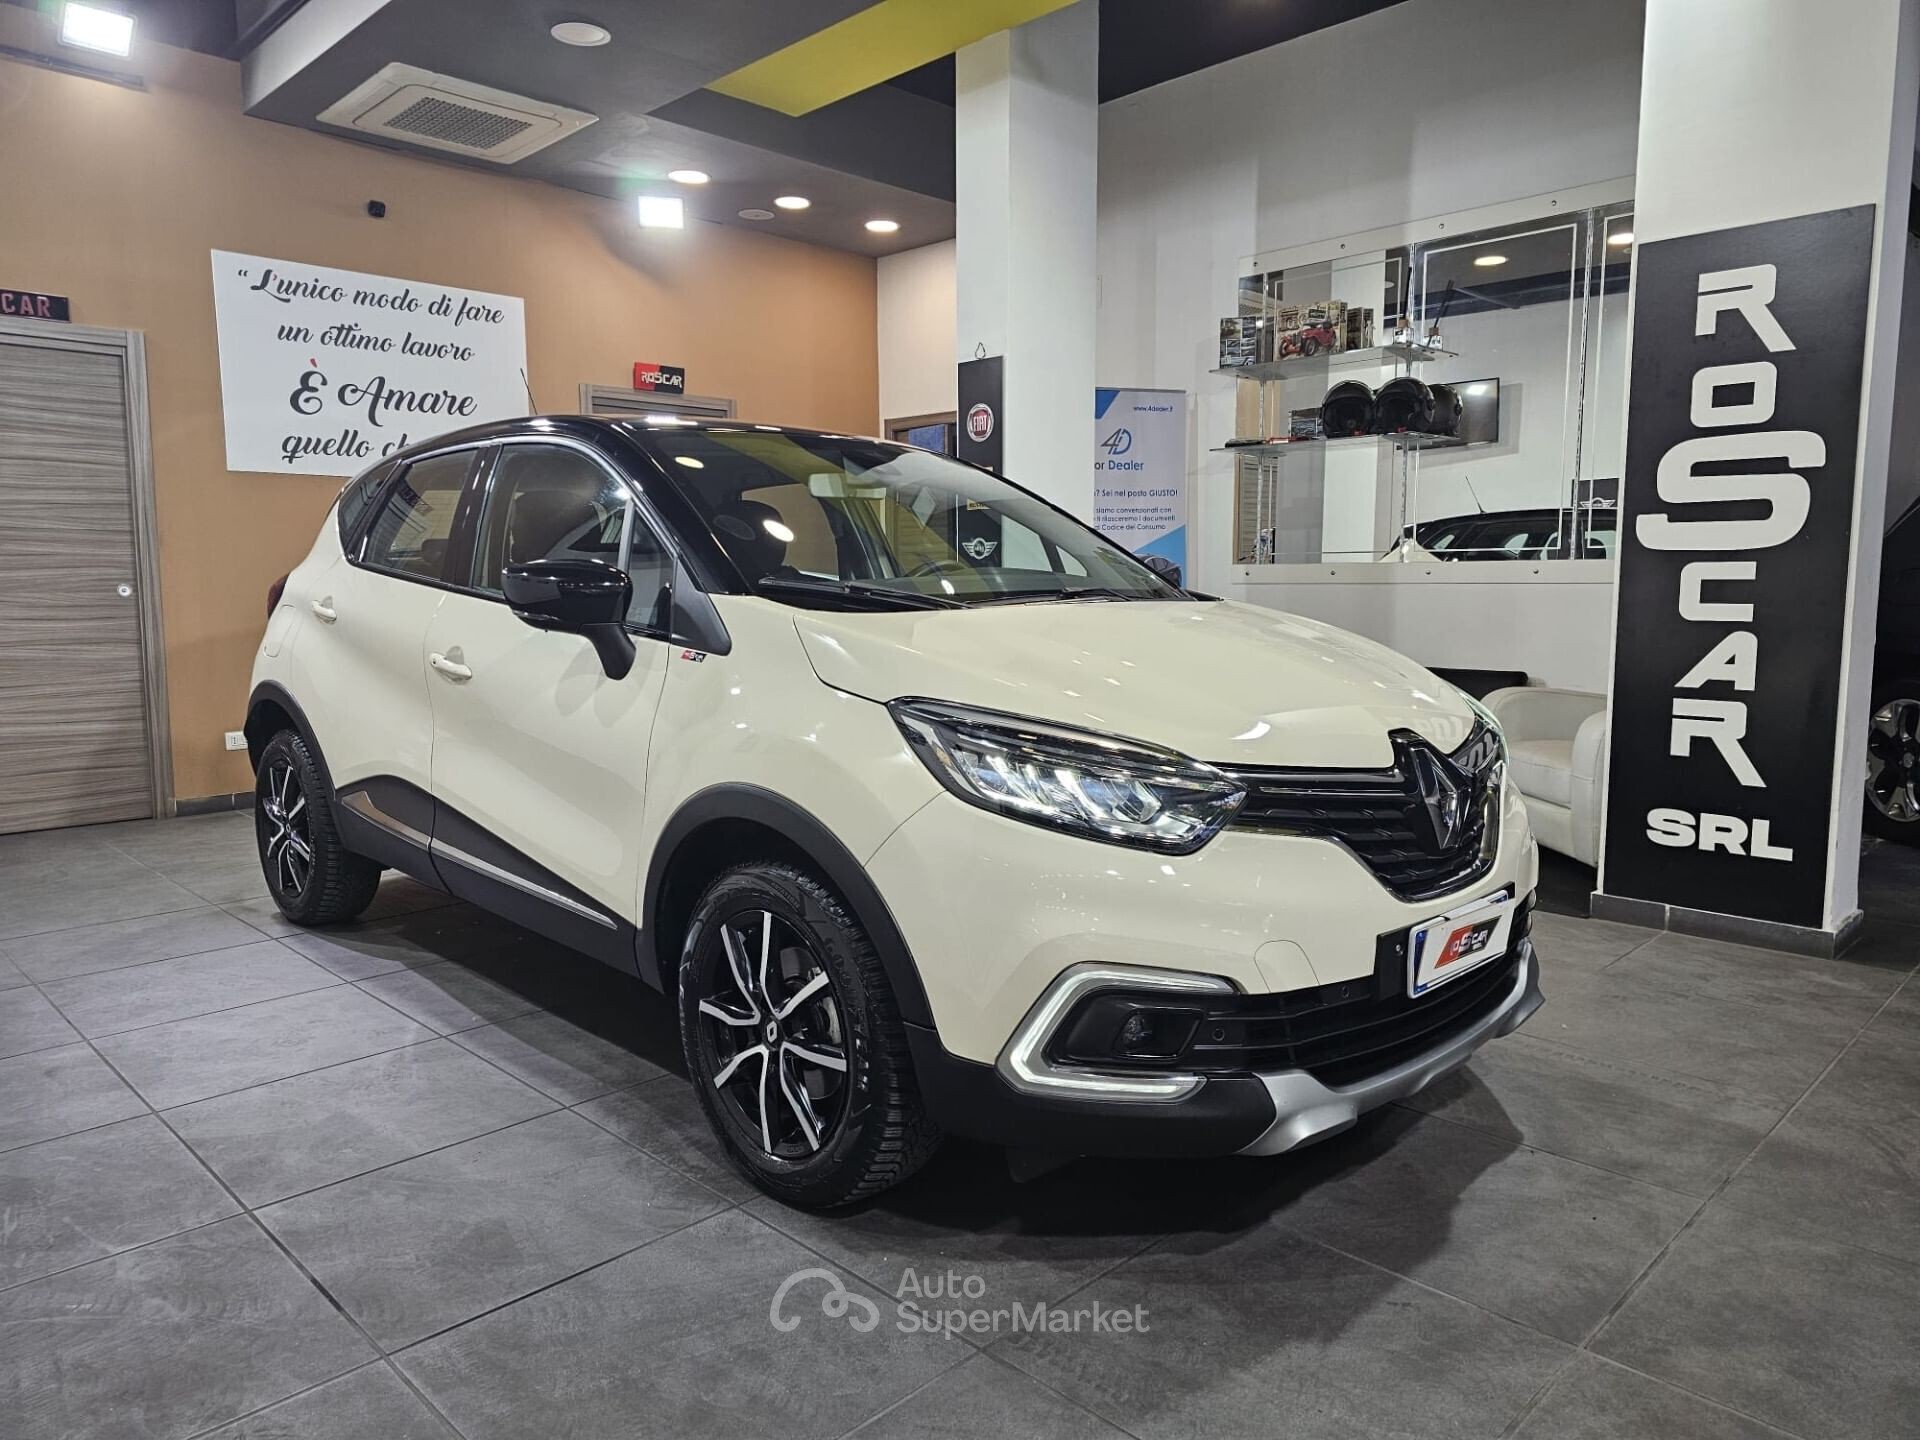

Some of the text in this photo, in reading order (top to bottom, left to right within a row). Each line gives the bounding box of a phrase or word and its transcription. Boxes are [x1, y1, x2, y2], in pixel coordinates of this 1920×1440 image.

[353, 288, 423, 312] modo
[428, 294, 453, 317] di
[454, 297, 505, 327] fare
[277, 323, 475, 361] un ottimo lavoro
[337, 376, 478, 427] Amare
[973, 415, 987, 432] FIAT
[281, 429, 374, 464] quello
[1108, 460, 1144, 471] Dealer
[1114, 489, 1126, 497] nel
[1127, 490, 1147, 498] posto
[1149, 489, 1178, 497] GIUSTO!
[1646, 808, 1793, 862] SRL
